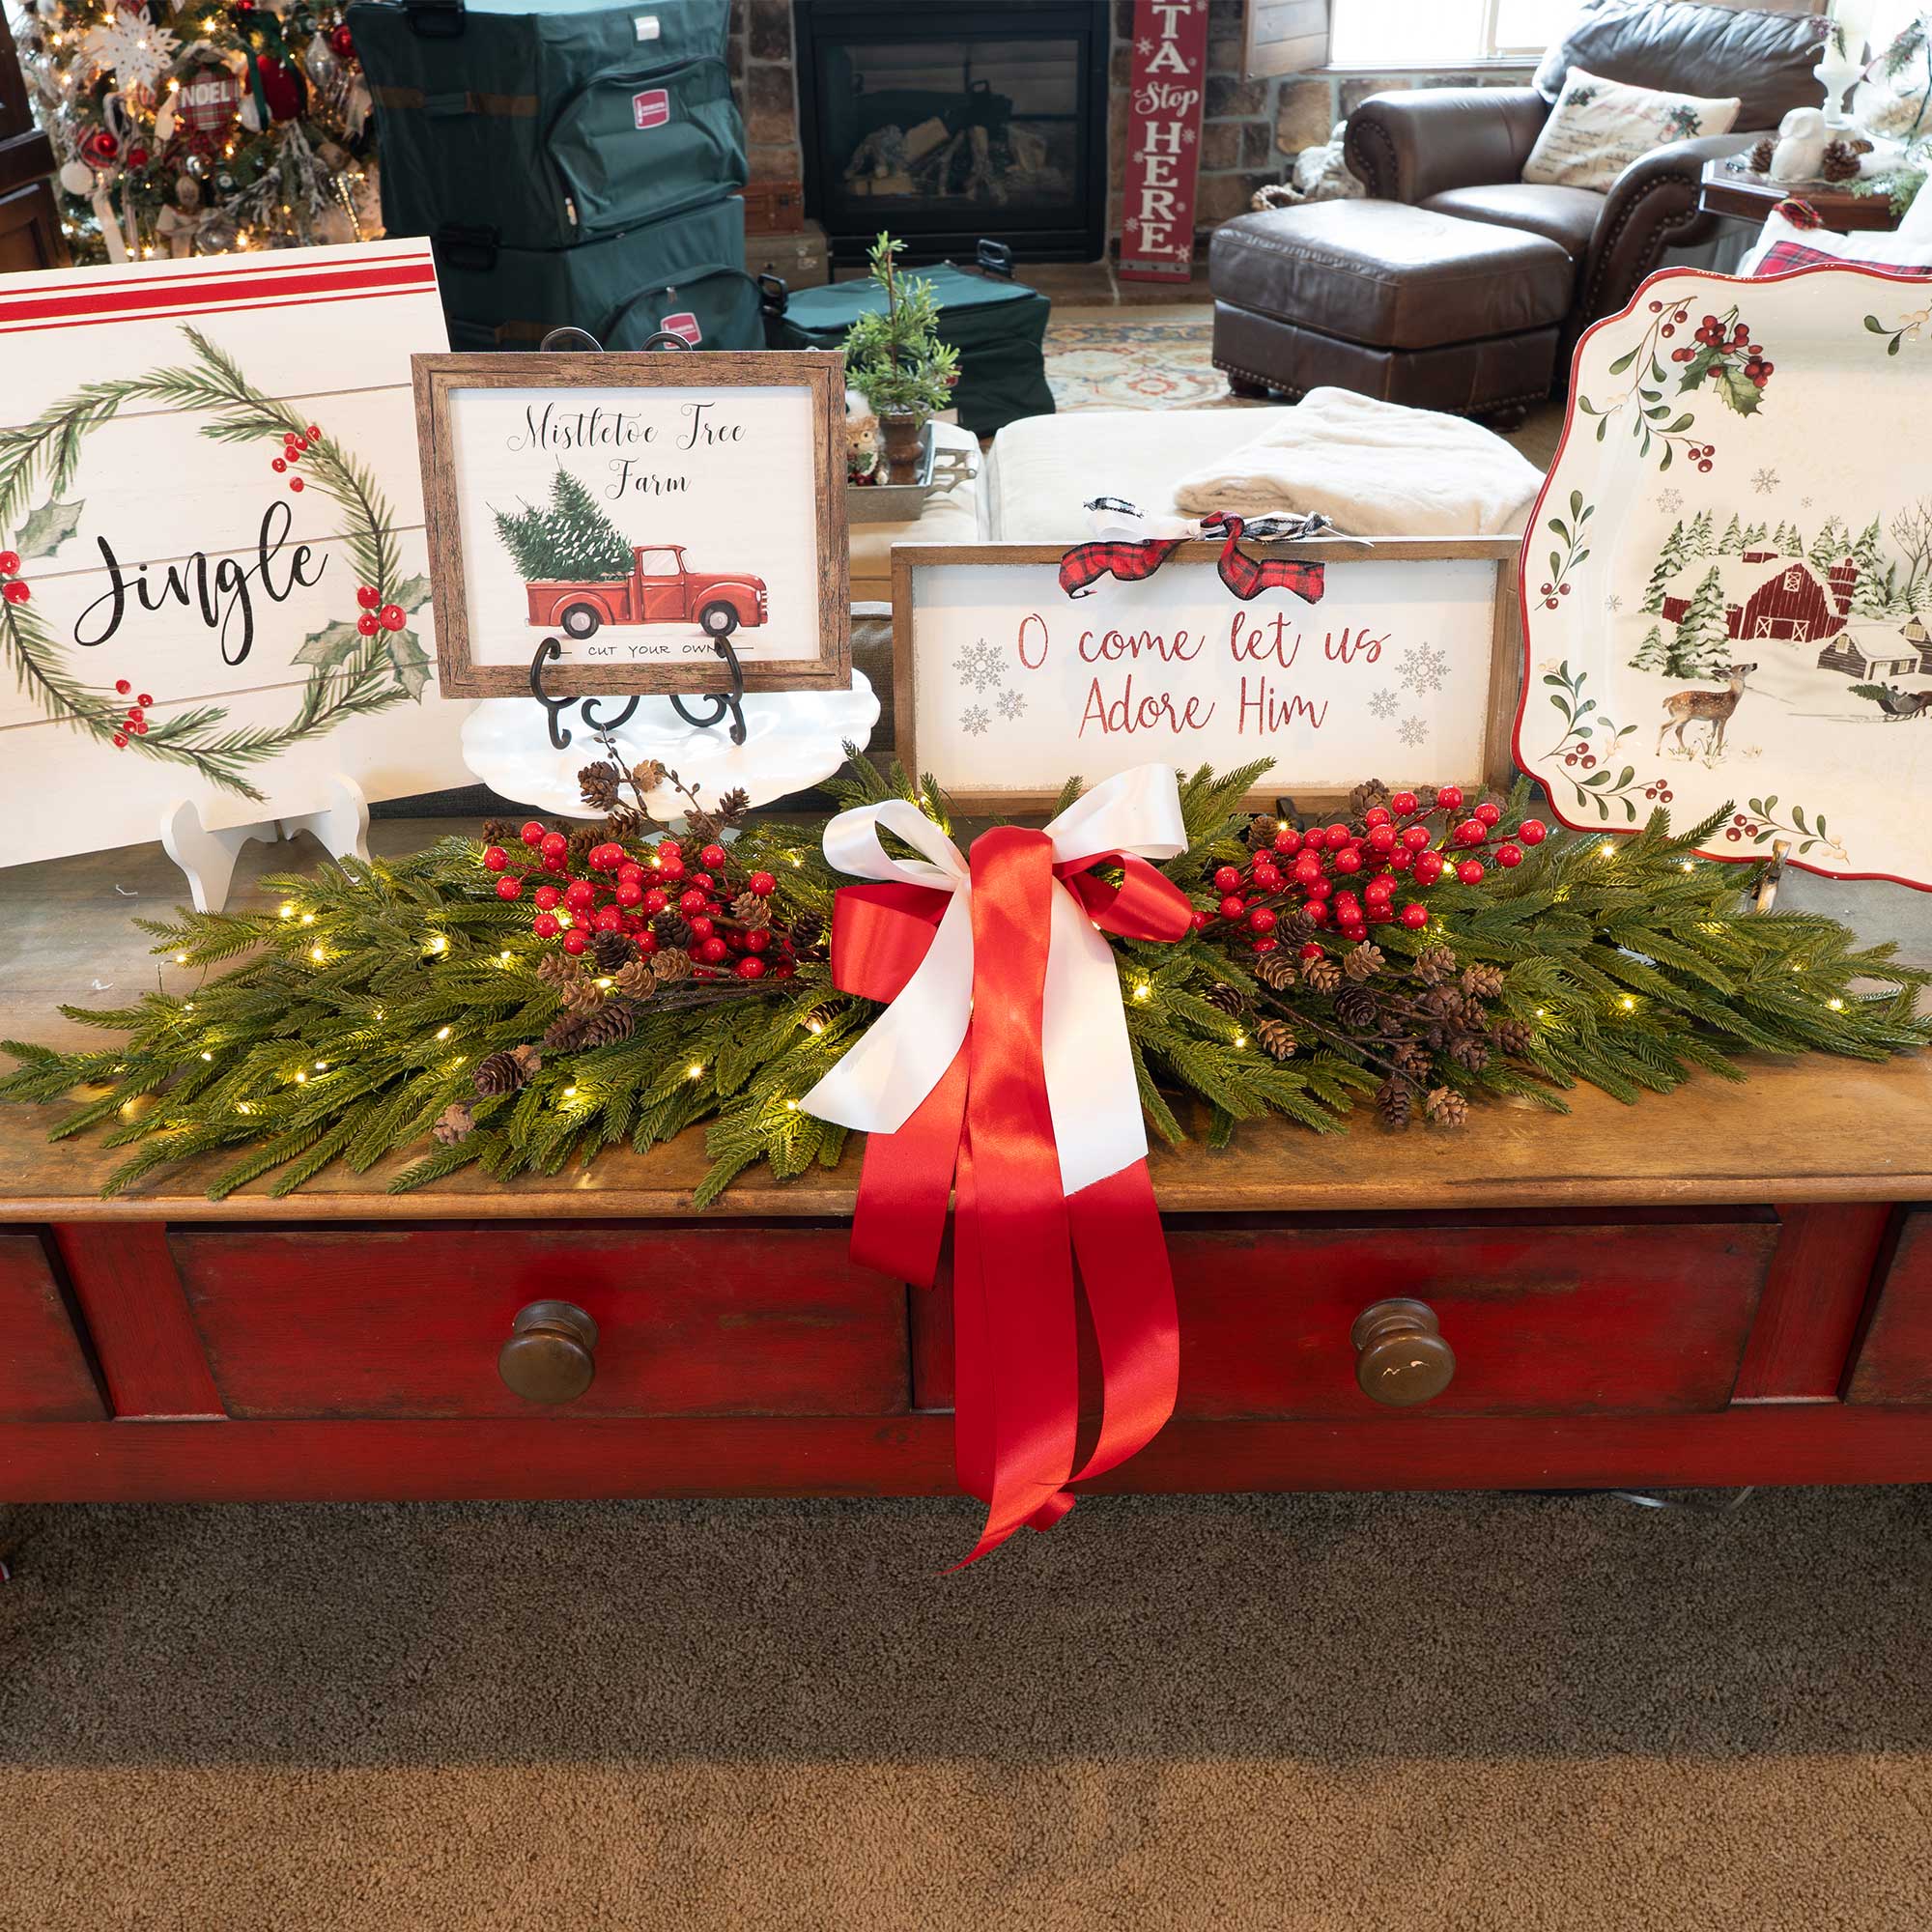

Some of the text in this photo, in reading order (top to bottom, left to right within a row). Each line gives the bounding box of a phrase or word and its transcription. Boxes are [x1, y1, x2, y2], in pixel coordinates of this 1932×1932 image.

[1145, 0, 1191, 73] TA
[181, 81, 231, 108] NOEL
[1133, 81, 1199, 117] Stop
[1138, 121, 1183, 254] HERE
[507, 402, 746, 451] Mistletoe Tree
[605, 457, 692, 499] Farm
[74, 500, 328, 666] Jingle
[588, 646, 618, 656] CUT
[628, 645, 671, 658] YOUR
[1018, 611, 1392, 669] O come let us
[1078, 673, 1328, 739] Adore Him
